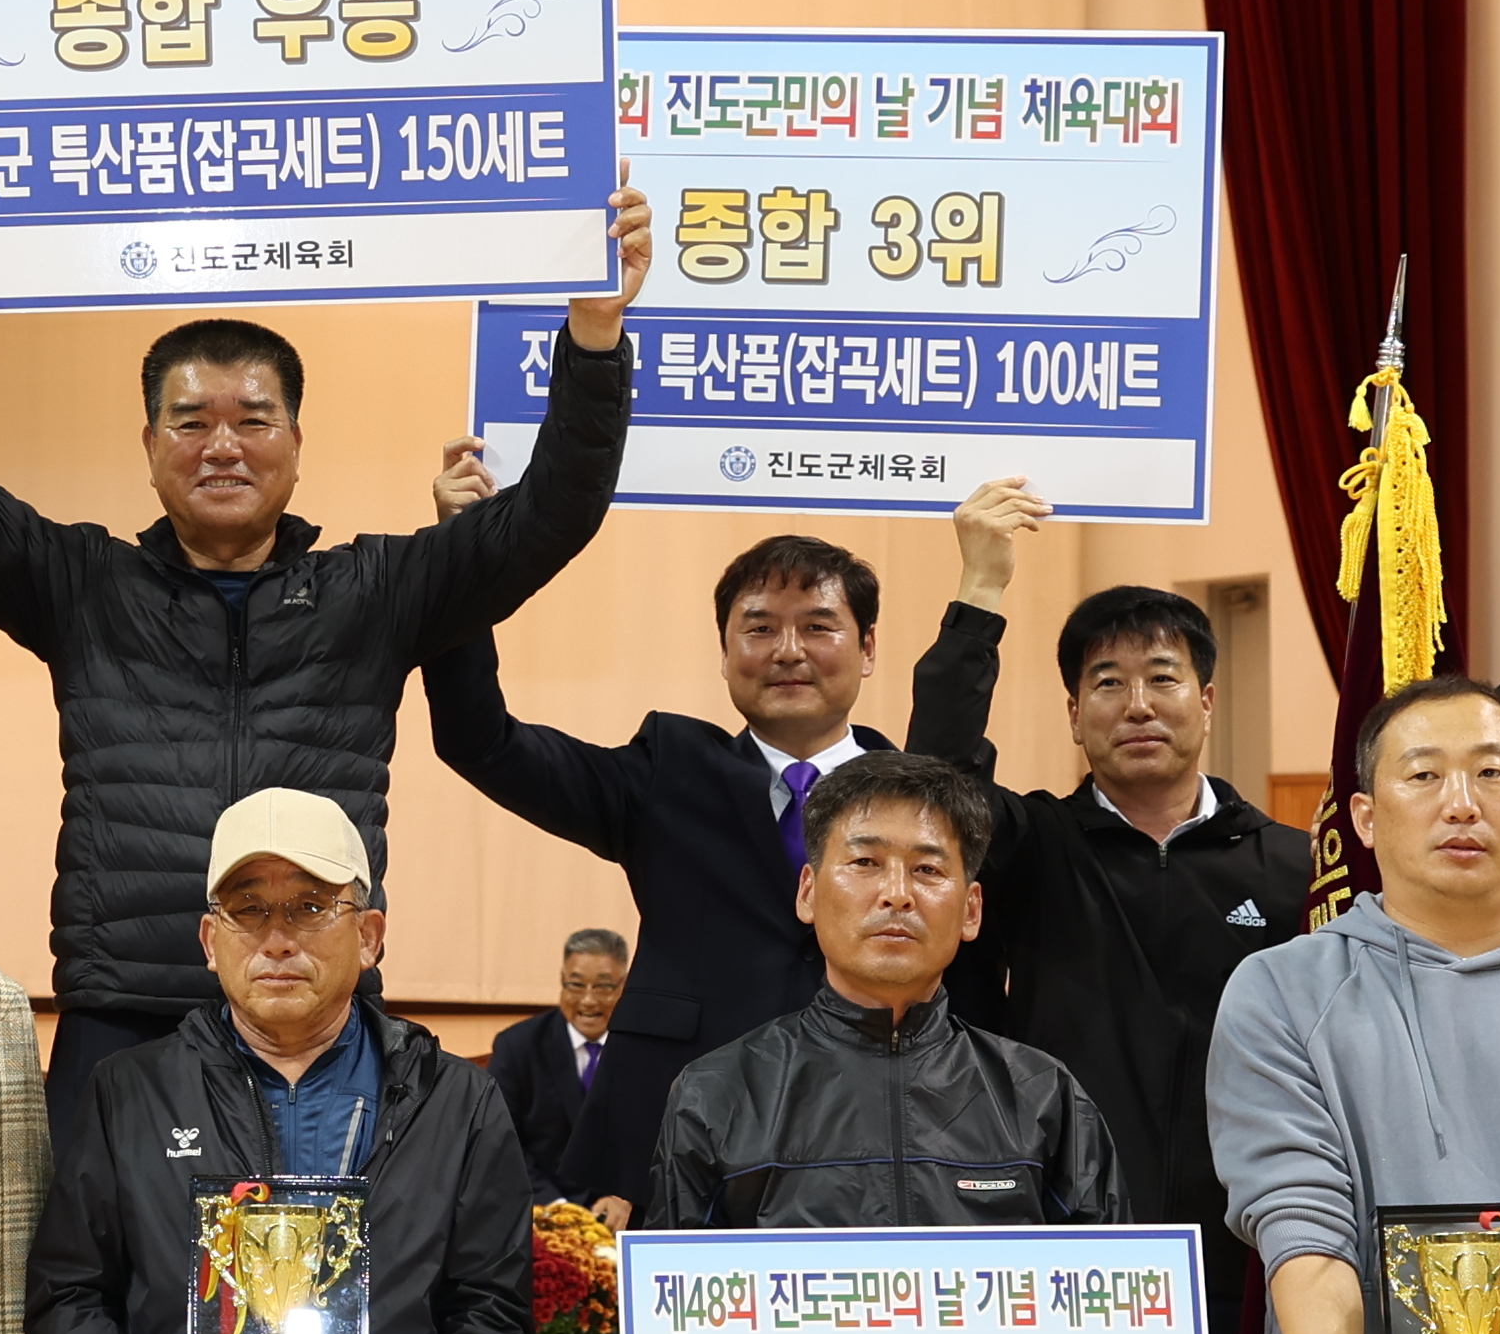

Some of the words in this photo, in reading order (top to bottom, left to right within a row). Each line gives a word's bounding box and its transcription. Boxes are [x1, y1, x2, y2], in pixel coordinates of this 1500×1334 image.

[666, 72, 859, 139] 진도군민의
[873, 76, 915, 139] 날
[927, 76, 1005, 141] 기념
[1021, 77, 1179, 144] 체육대회
[50, 112, 381, 197] 특산품(잡곡세트)
[399, 110, 570, 183] 150세트
[169, 240, 356, 272] 진도군체육회
[676, 187, 840, 283] 종합
[870, 192, 1005, 286] 3위
[657, 333, 979, 410] 특산품(잡곡세트)
[996, 340, 1162, 410] 100세트
[768, 452, 947, 482] 진도군체육회
[1225, 914, 1267, 928] adidas
[166, 1146, 203, 1159] hummel
[654, 1271, 758, 1332] 제48회
[769, 1270, 923, 1329] 진도군민의
[934, 1271, 965, 1327] 날
[975, 1269, 1035, 1327] 기념
[1050, 1268, 1173, 1329] 체육대회
